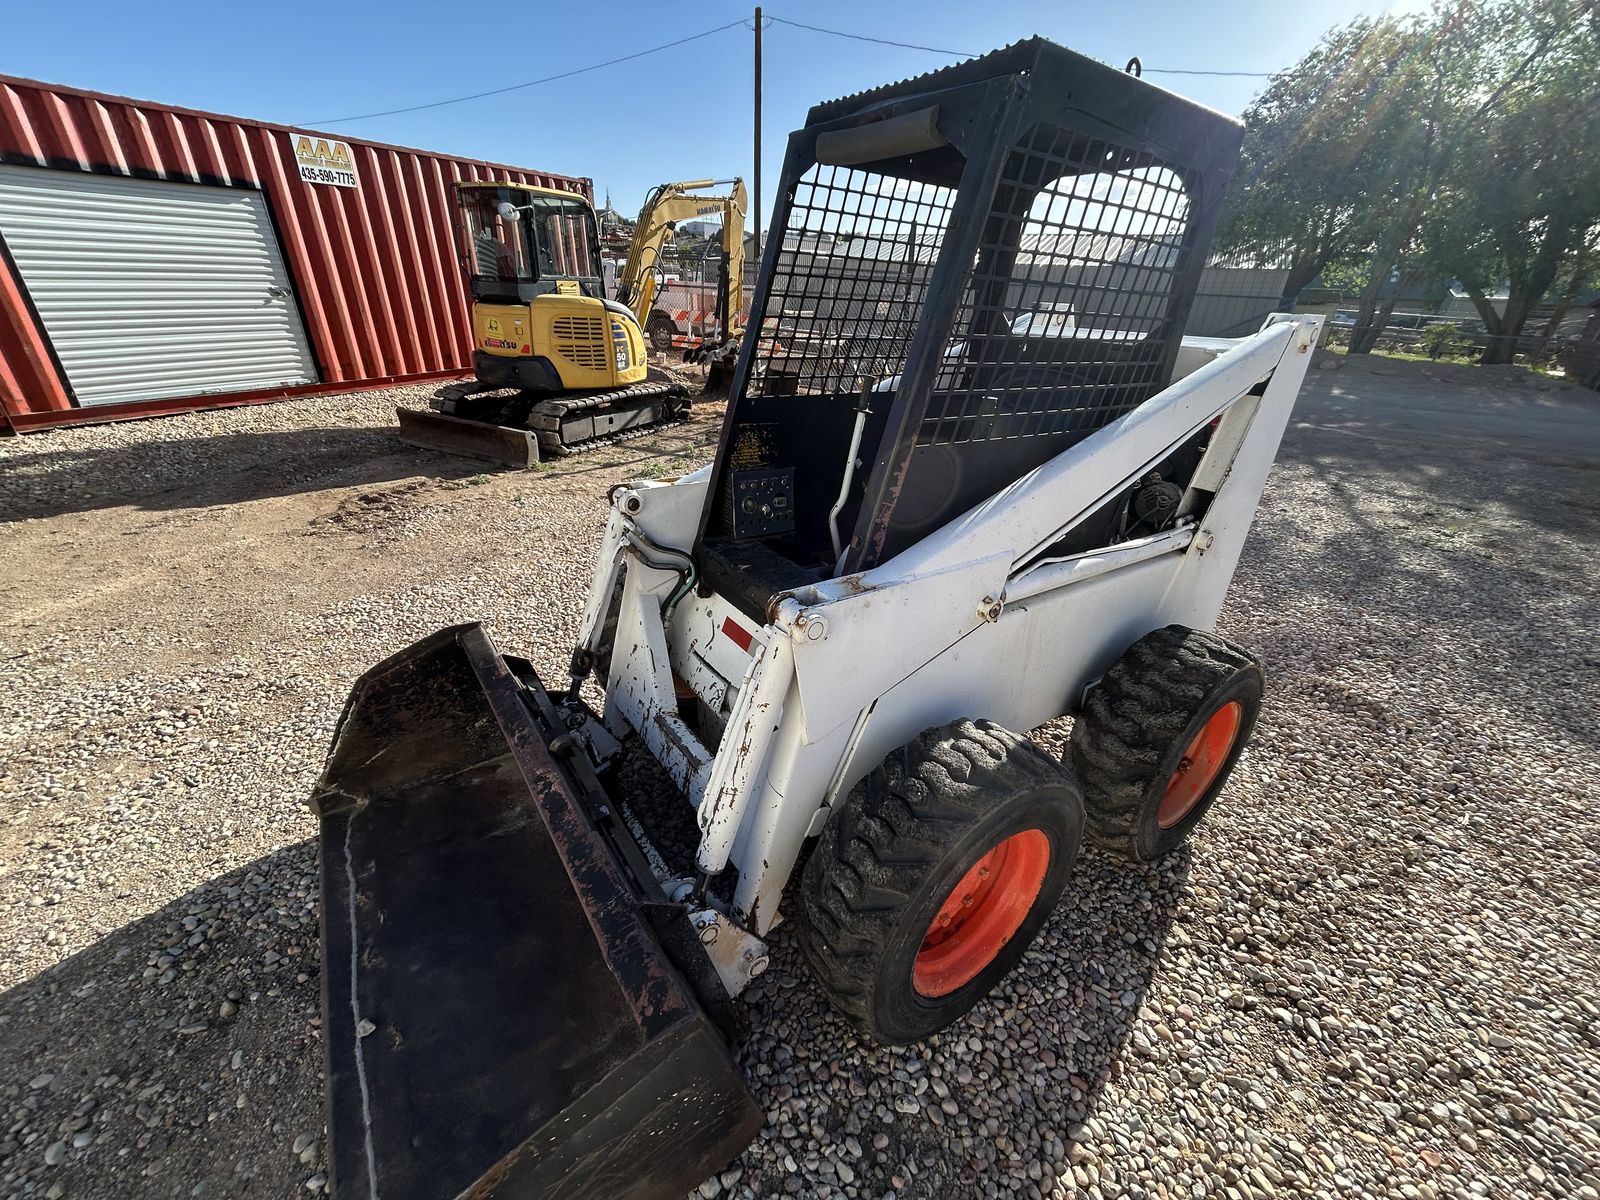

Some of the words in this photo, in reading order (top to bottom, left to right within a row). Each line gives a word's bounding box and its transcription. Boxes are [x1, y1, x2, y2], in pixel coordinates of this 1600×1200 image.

[296, 136, 351, 162] AAA
[301, 166, 356, 186] 435-590-7775
[696, 204, 721, 216] KOMATSU
[484, 339, 517, 349] KTSU
[616, 352, 626, 361] 50
